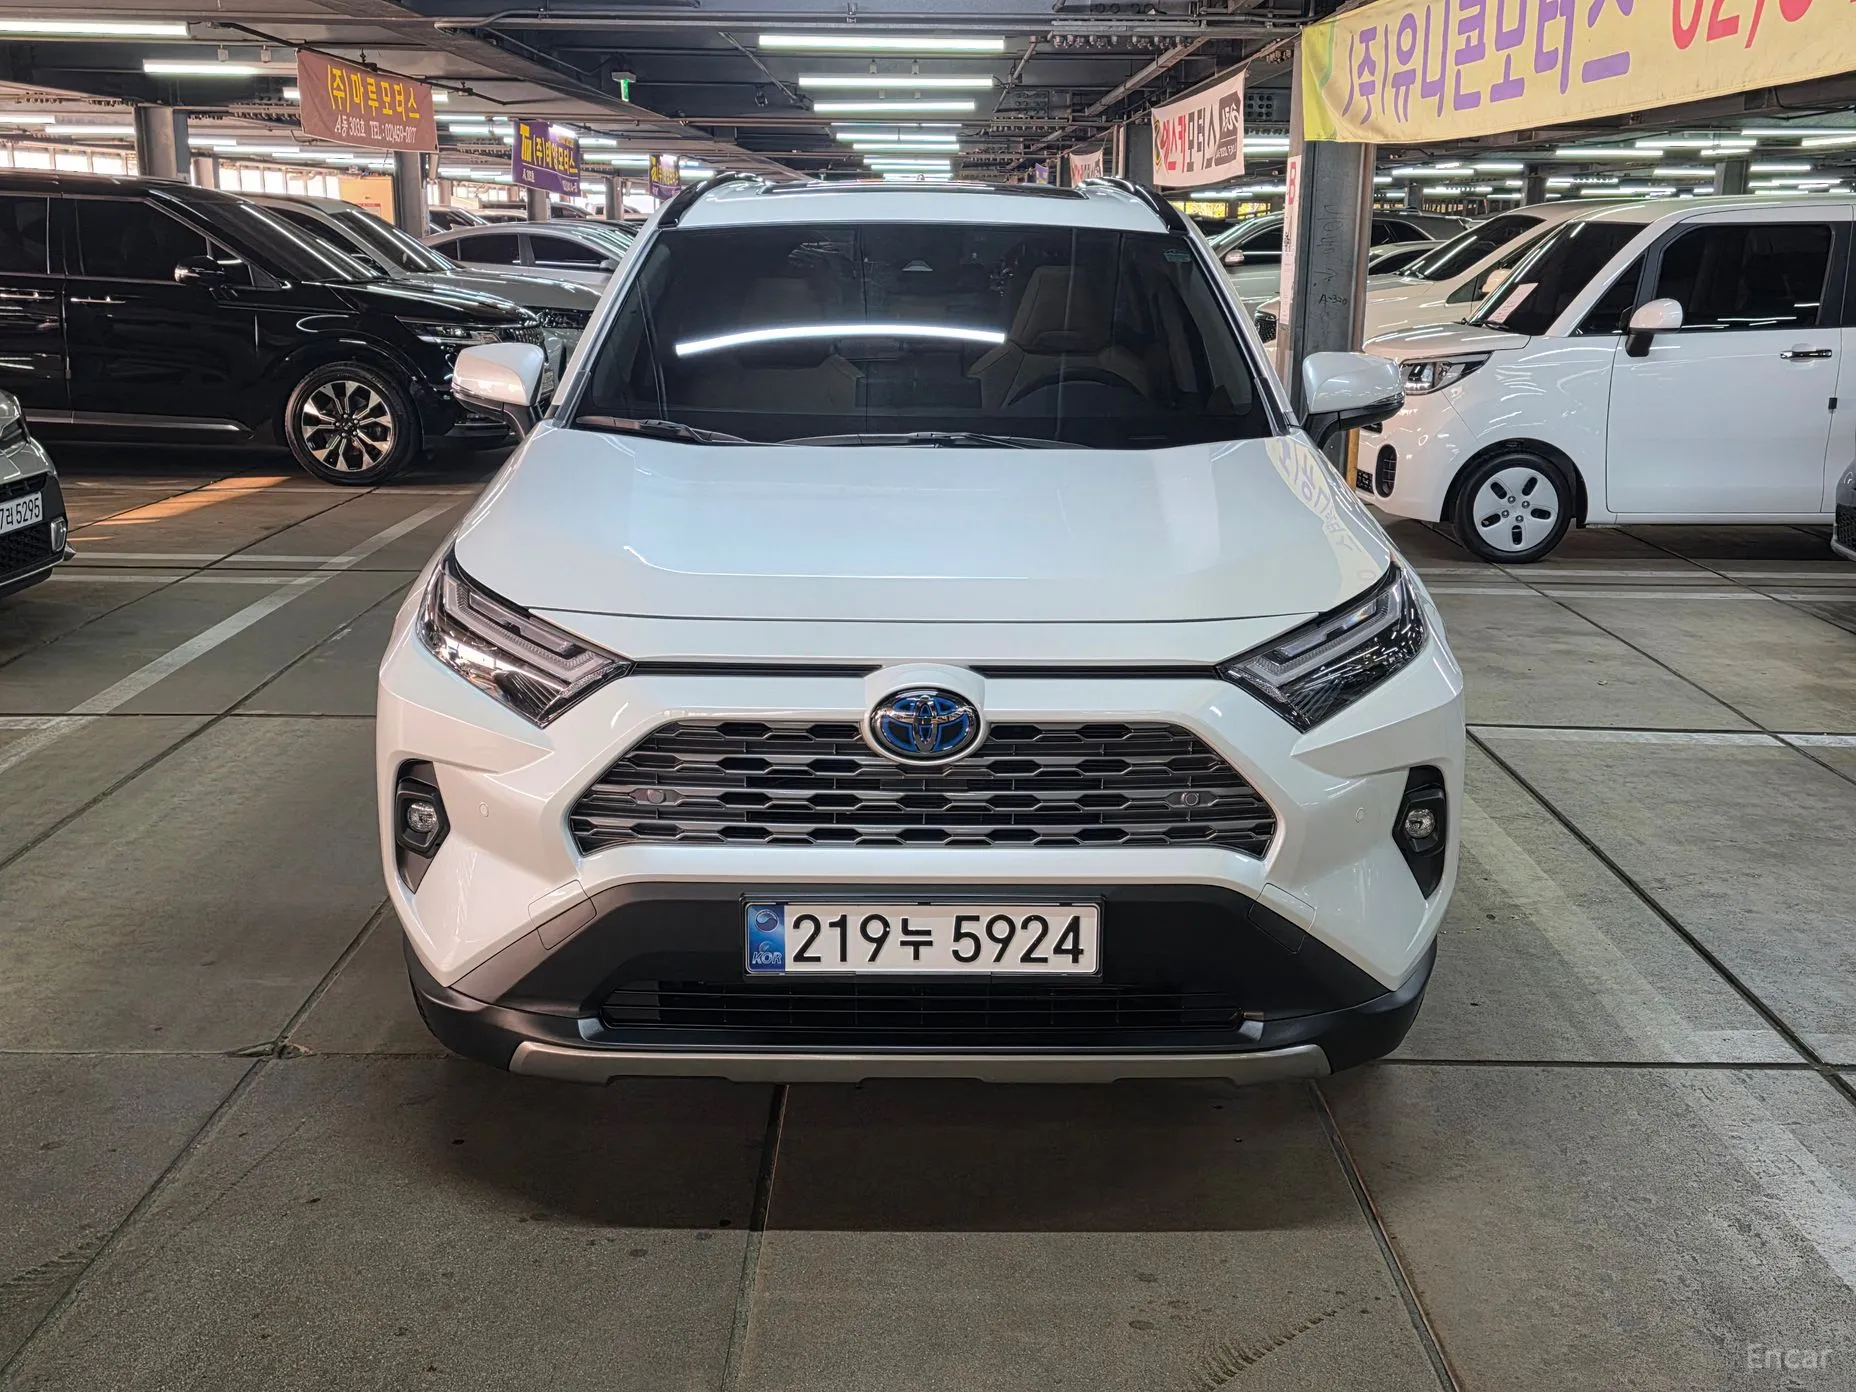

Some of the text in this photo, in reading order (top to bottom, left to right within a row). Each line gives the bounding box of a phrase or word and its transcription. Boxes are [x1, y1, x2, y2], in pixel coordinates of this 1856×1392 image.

[327, 64, 420, 121] (주)마루모터스
[16, 497, 40, 524] 5295
[751, 950, 782, 965] KOR
[792, 913, 1084, 964] 219누 5924
